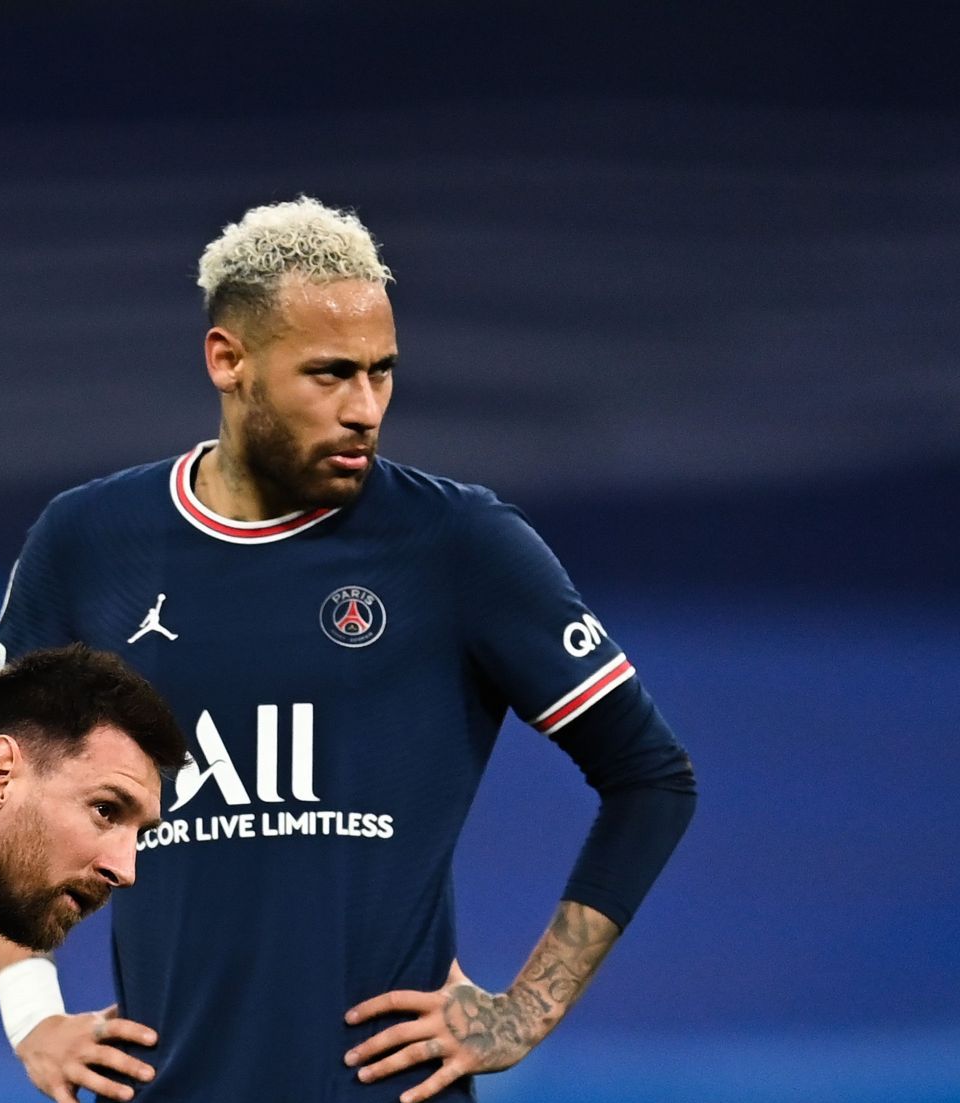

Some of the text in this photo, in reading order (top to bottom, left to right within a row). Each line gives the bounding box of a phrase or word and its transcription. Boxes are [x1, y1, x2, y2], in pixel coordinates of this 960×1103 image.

[332, 589, 375, 606] PARIS
[195, 813, 256, 842] LIVE
[261, 811, 394, 839] LIMITLESS
